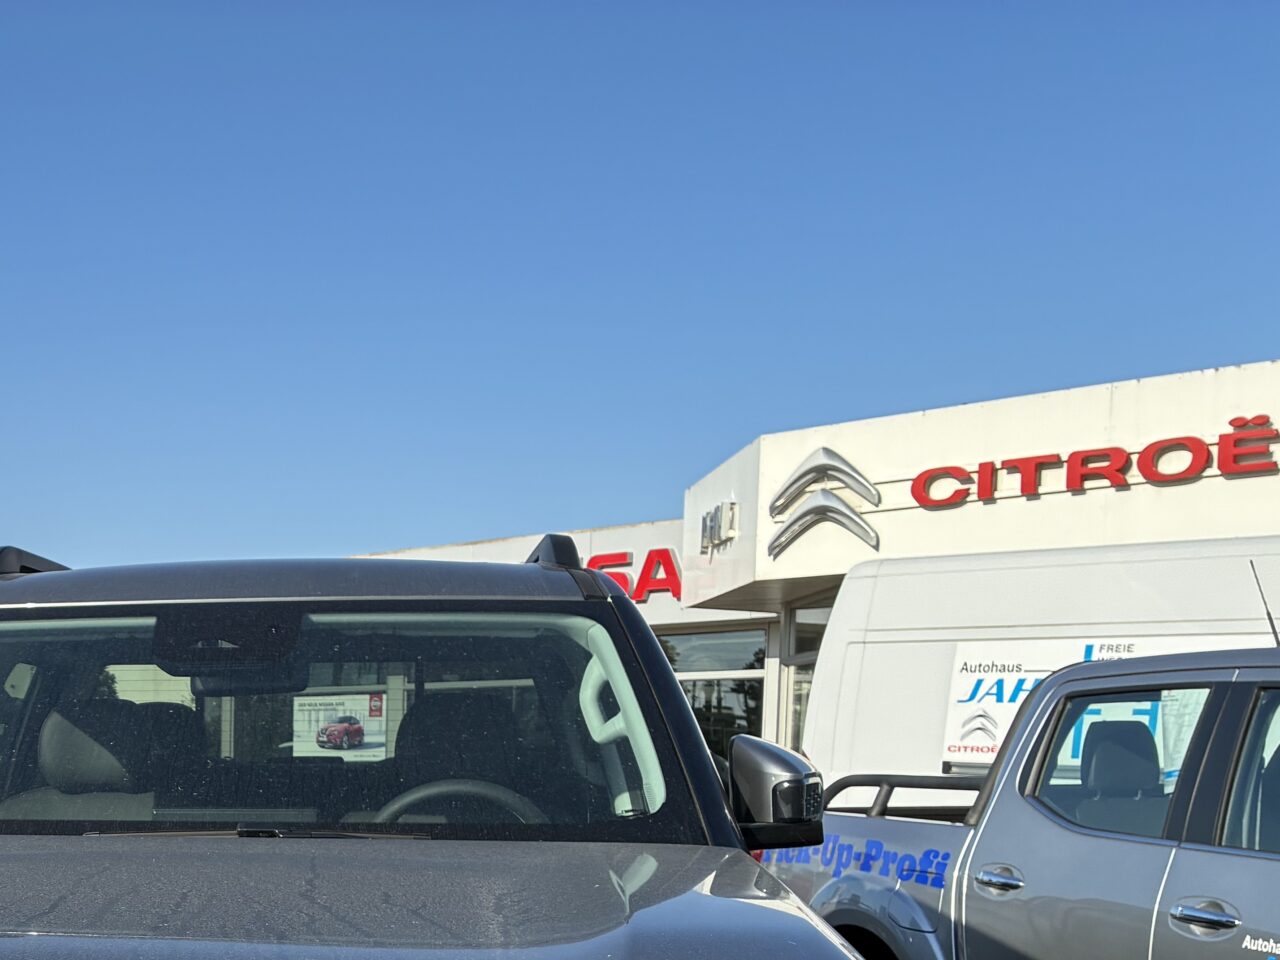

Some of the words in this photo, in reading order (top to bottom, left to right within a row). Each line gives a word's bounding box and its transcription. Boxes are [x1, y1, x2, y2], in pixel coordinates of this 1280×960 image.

[911, 414, 1280, 508] CITROË
[1098, 643, 1135, 654] FREIE
[960, 661, 1023, 674] Autohaus
